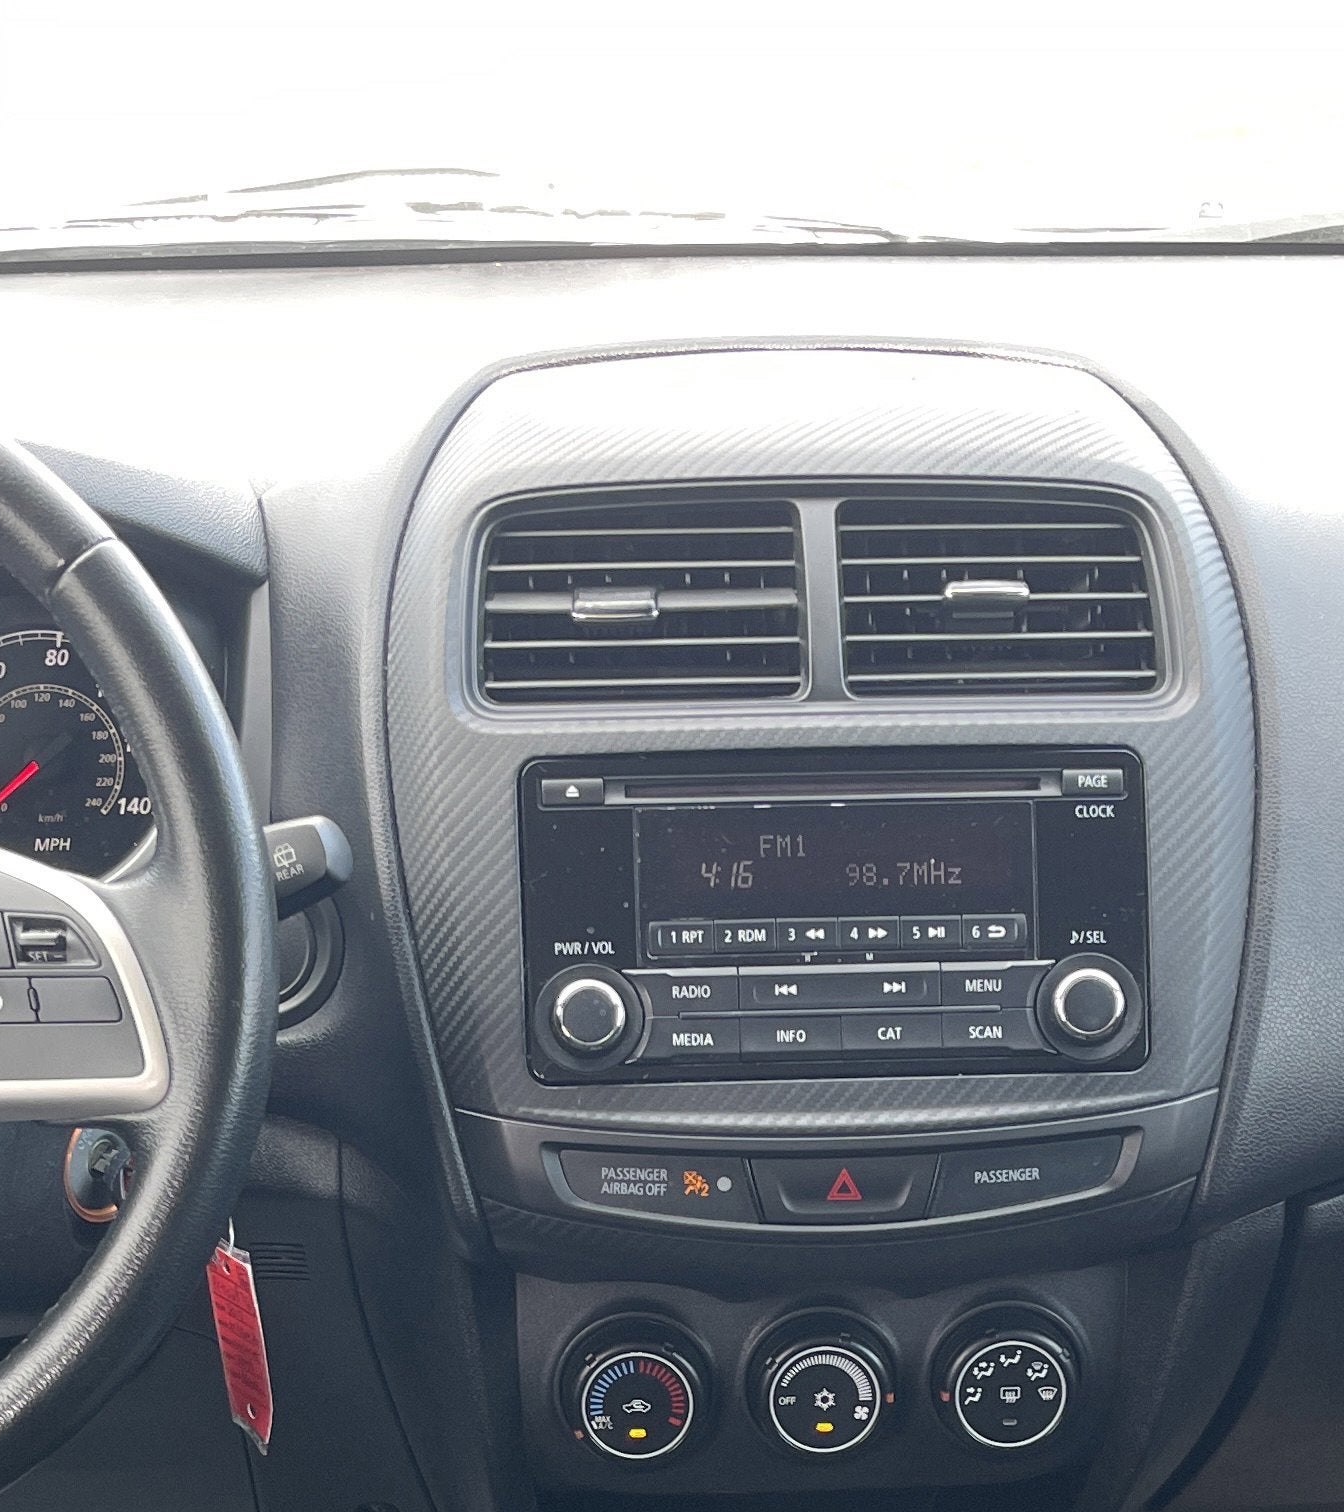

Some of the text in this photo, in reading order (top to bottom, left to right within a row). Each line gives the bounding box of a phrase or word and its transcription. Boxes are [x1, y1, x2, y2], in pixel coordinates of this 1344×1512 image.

[44, 649, 69, 667] 80
[10, 699, 27, 709] 100
[34, 692, 51, 703] 120
[58, 698, 75, 708] 140
[79, 712, 95, 722] 160
[91, 730, 109, 740] 180
[99, 753, 116, 764] 200
[95, 777, 114, 787] 220
[1077, 775, 1108, 788] PAGE
[85, 797, 102, 807] 240
[117, 797, 152, 815] 140
[38, 813, 64, 823] km/h
[1074, 805, 1115, 818] CLOCK
[34, 837, 71, 851] MPH
[759, 834, 806, 858] FM1
[275, 863, 305, 882] REAR
[700, 860, 754, 890] 4:16
[845, 861, 962, 887] 98.7MHz
[670, 930, 705, 944] 1 RPT
[724, 929, 767, 943] 2 RDM
[787, 928, 796, 941] 3
[849, 926, 859, 940] 4
[911, 926, 921, 940] 5
[971, 925, 980, 939] 6
[671, 985, 712, 999] RADIO
[965, 979, 1003, 993] MENU
[776, 1029, 807, 1043] INFO
[877, 1026, 903, 1040] CAT
[968, 1025, 1003, 1039] SCAN
[672, 1032, 714, 1047] MEDIA
[601, 1167, 668, 1182] PASSENGER
[974, 1167, 1040, 1184] PASSENGER
[600, 1182, 668, 1196] AIRBAG OFF
[778, 1396, 797, 1406] OFF
